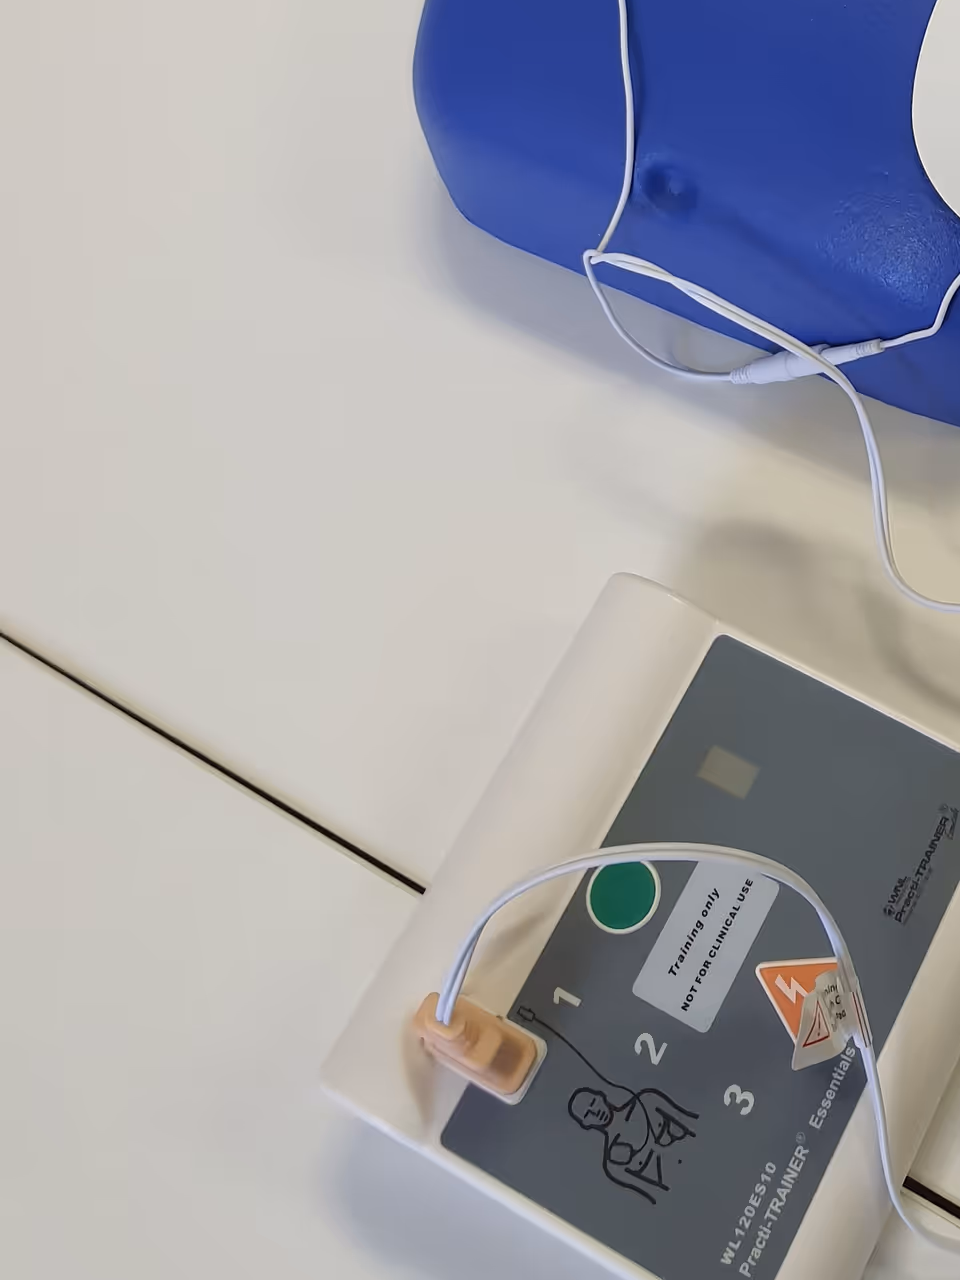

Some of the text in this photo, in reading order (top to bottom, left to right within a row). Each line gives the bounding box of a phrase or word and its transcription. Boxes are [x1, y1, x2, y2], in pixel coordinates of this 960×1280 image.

[668, 887, 721, 977] Training only
[680, 878, 754, 1012] NOT FOR CLINICAL USE
[553, 986, 582, 1007] 1
[634, 1032, 668, 1065] 2
[809, 1046, 856, 1130] Essentials
[724, 1084, 755, 1116] 3
[720, 1161, 777, 1266] WL120ES10
